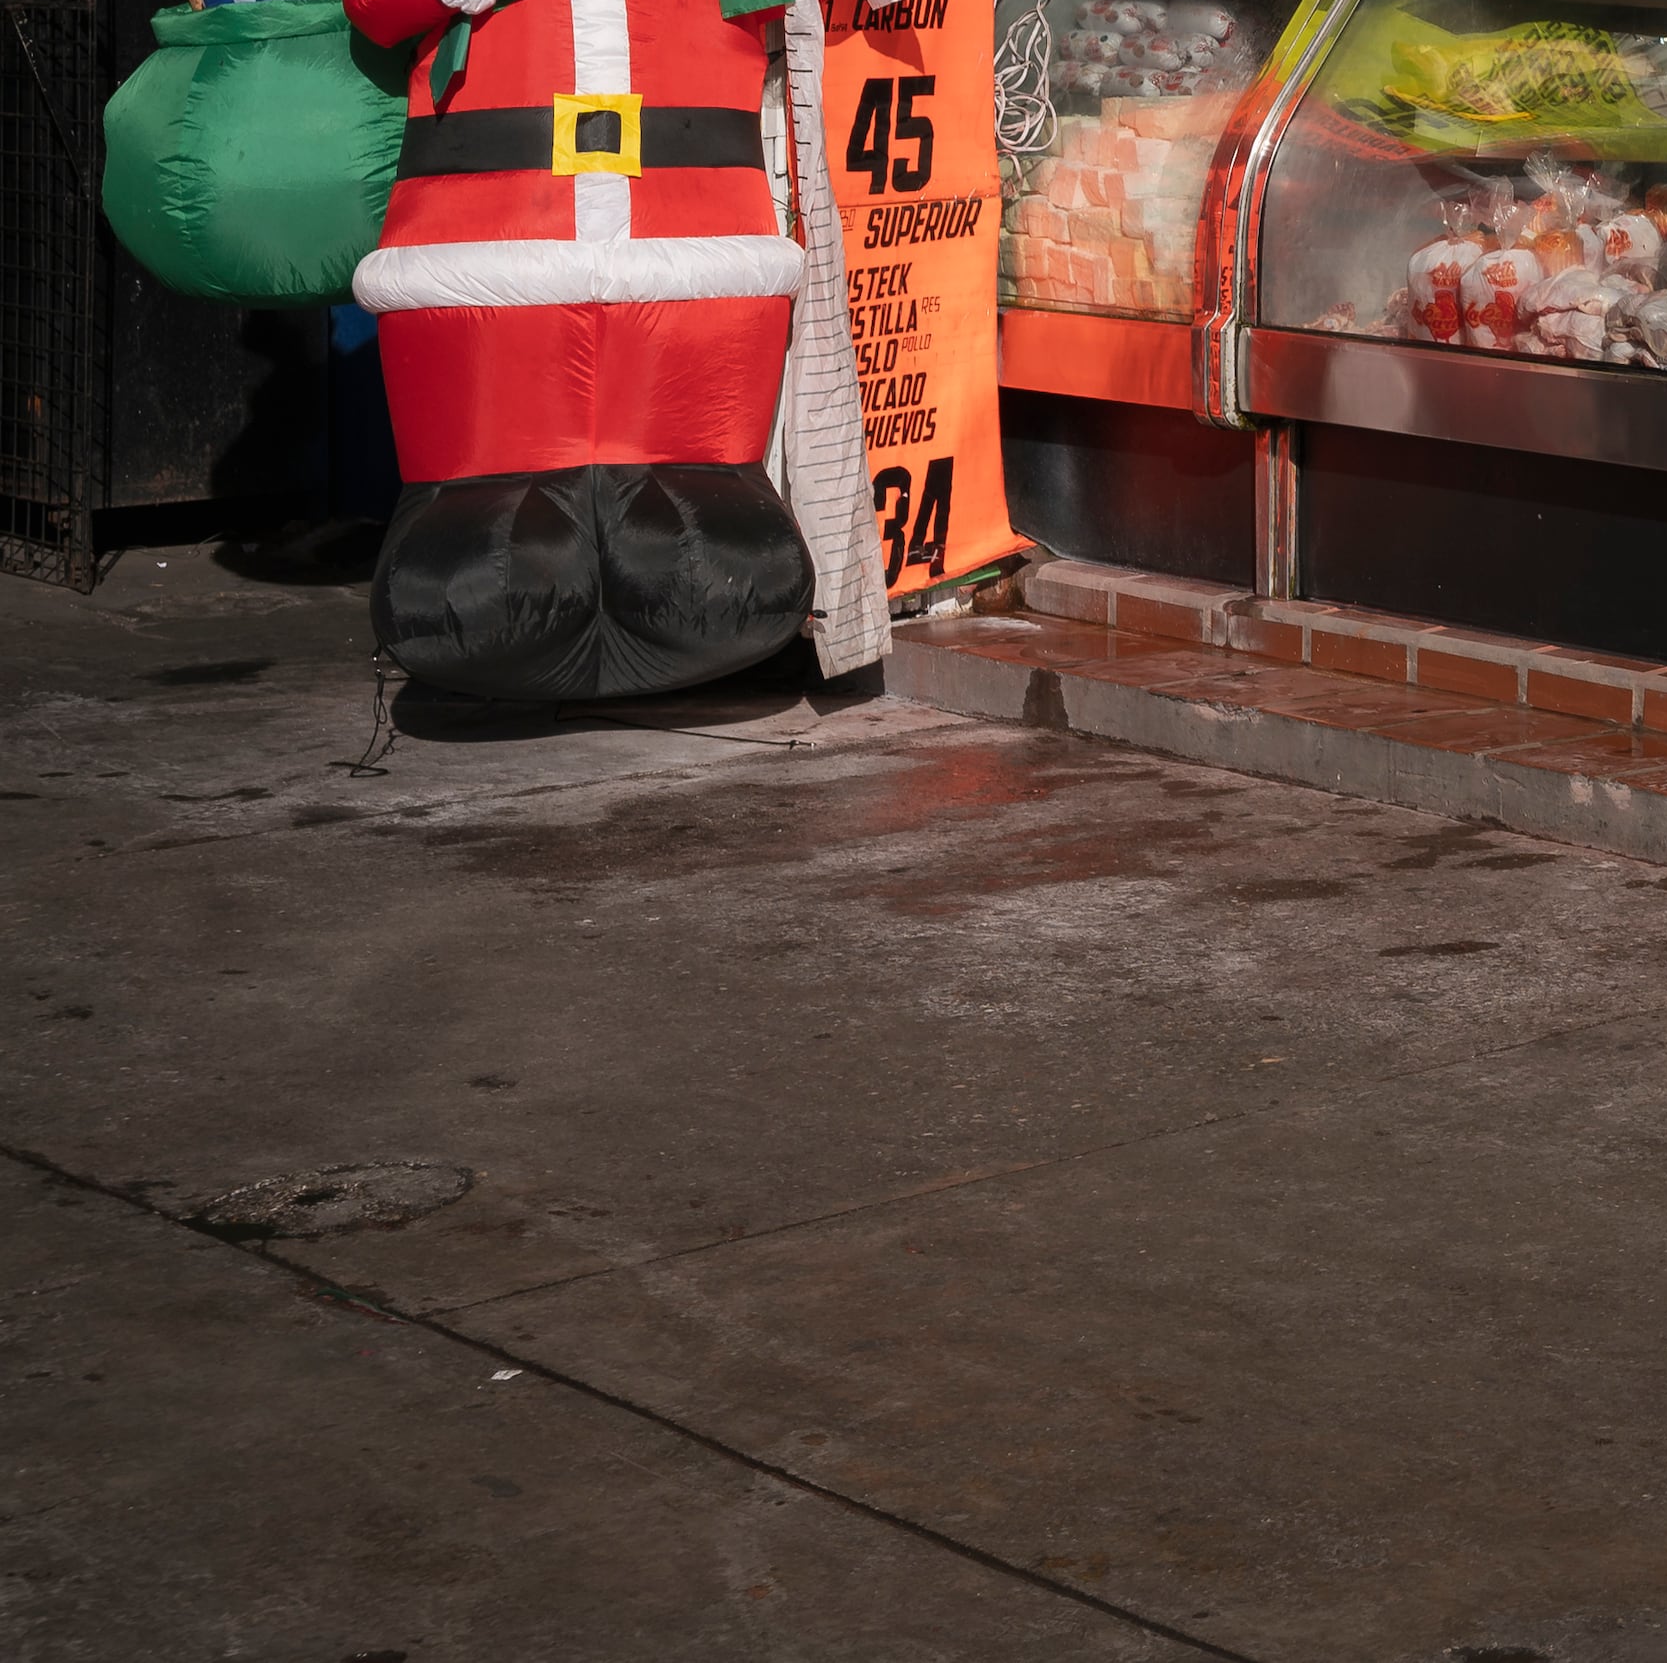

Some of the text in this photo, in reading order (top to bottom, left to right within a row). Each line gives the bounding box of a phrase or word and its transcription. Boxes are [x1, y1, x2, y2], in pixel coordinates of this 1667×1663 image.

[847, 75, 935, 195] 45
[864, 198, 983, 249] SUPERIOR
[865, 408, 937, 450] HUEVOS
[873, 457, 953, 588] 34
